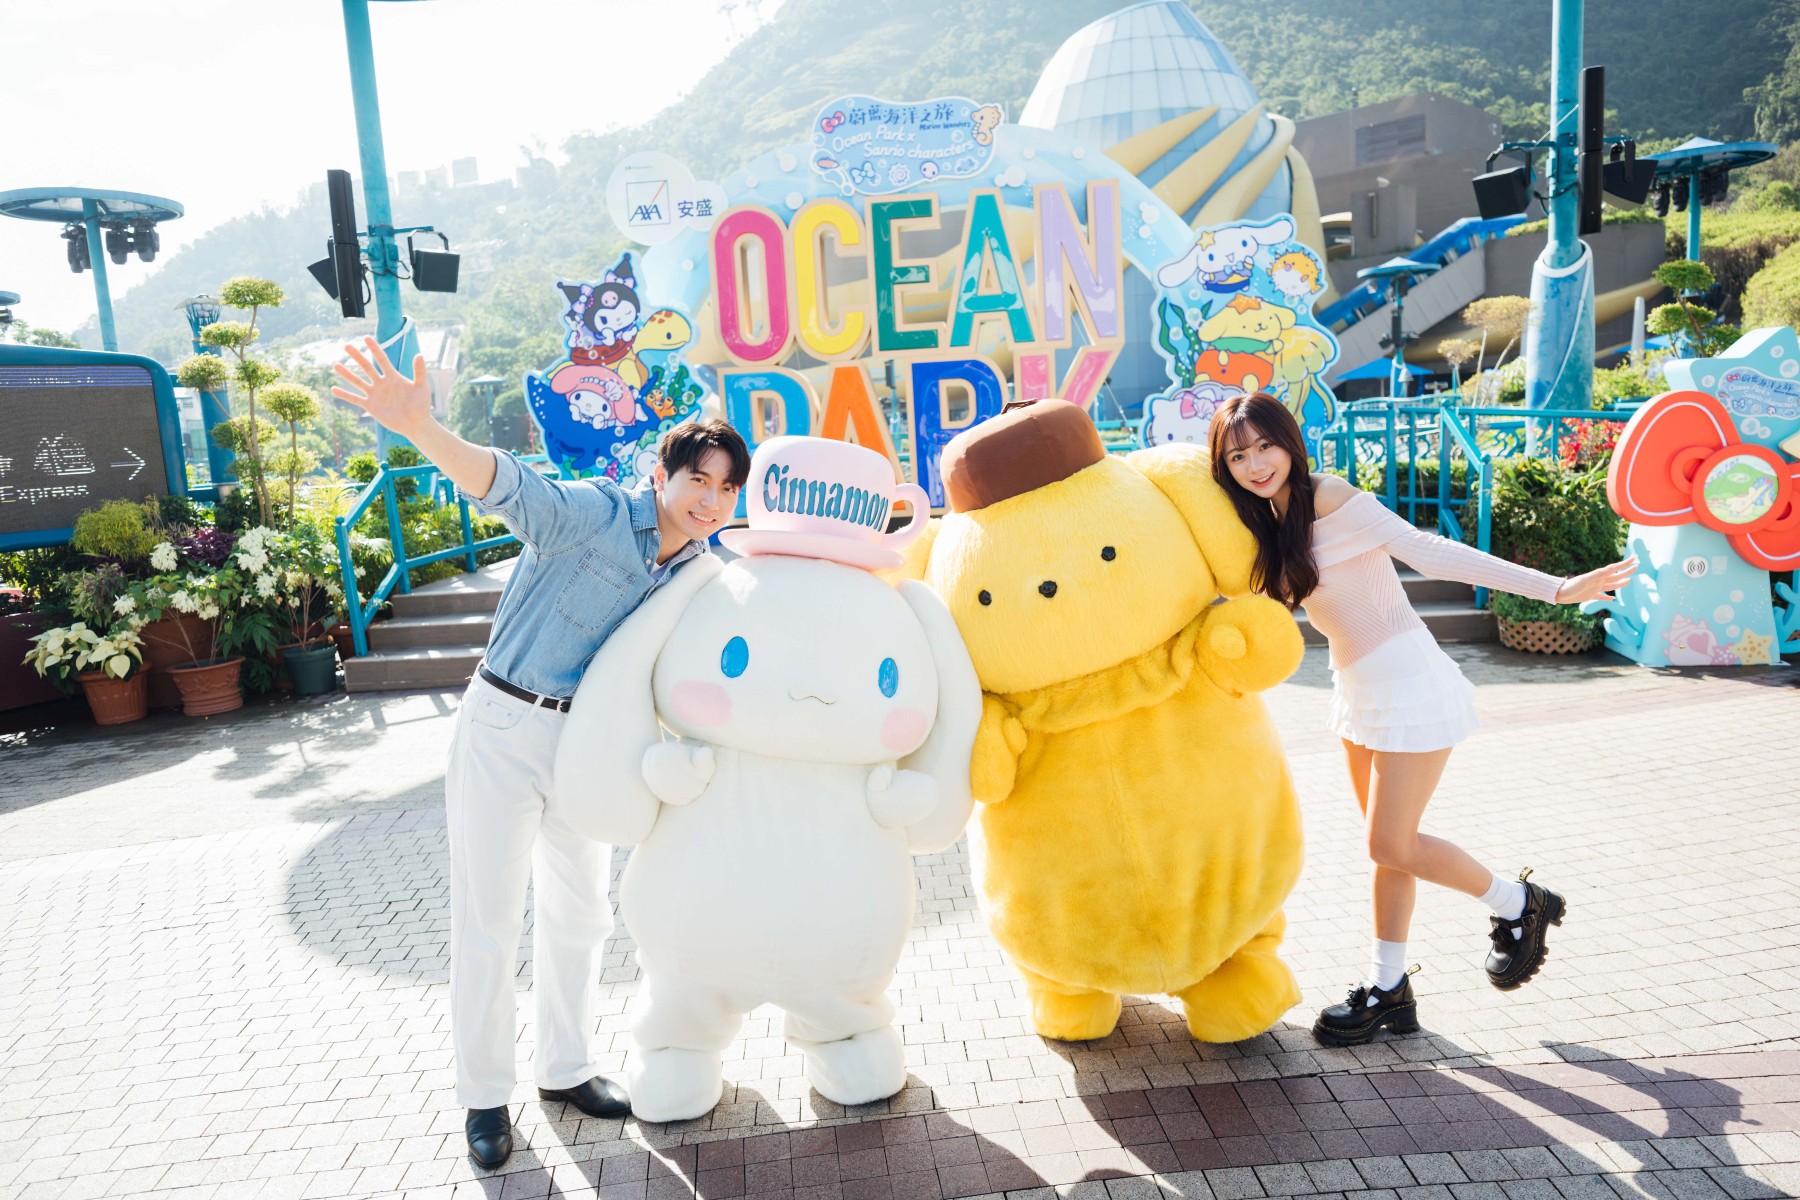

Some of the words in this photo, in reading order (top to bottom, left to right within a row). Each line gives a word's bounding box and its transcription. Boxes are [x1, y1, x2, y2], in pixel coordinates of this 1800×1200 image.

[848, 103, 954, 125] 蔚藍海洋之旅
[832, 130, 872, 153] Ocean
[875, 124, 906, 142] Park
[863, 140, 905, 158] Sanrio
[907, 139, 974, 159] characters
[629, 203, 662, 222] AXA
[677, 198, 713, 219] 安盛
[711, 180, 1122, 365] OCEAN
[763, 463, 888, 532] Cinnamon
